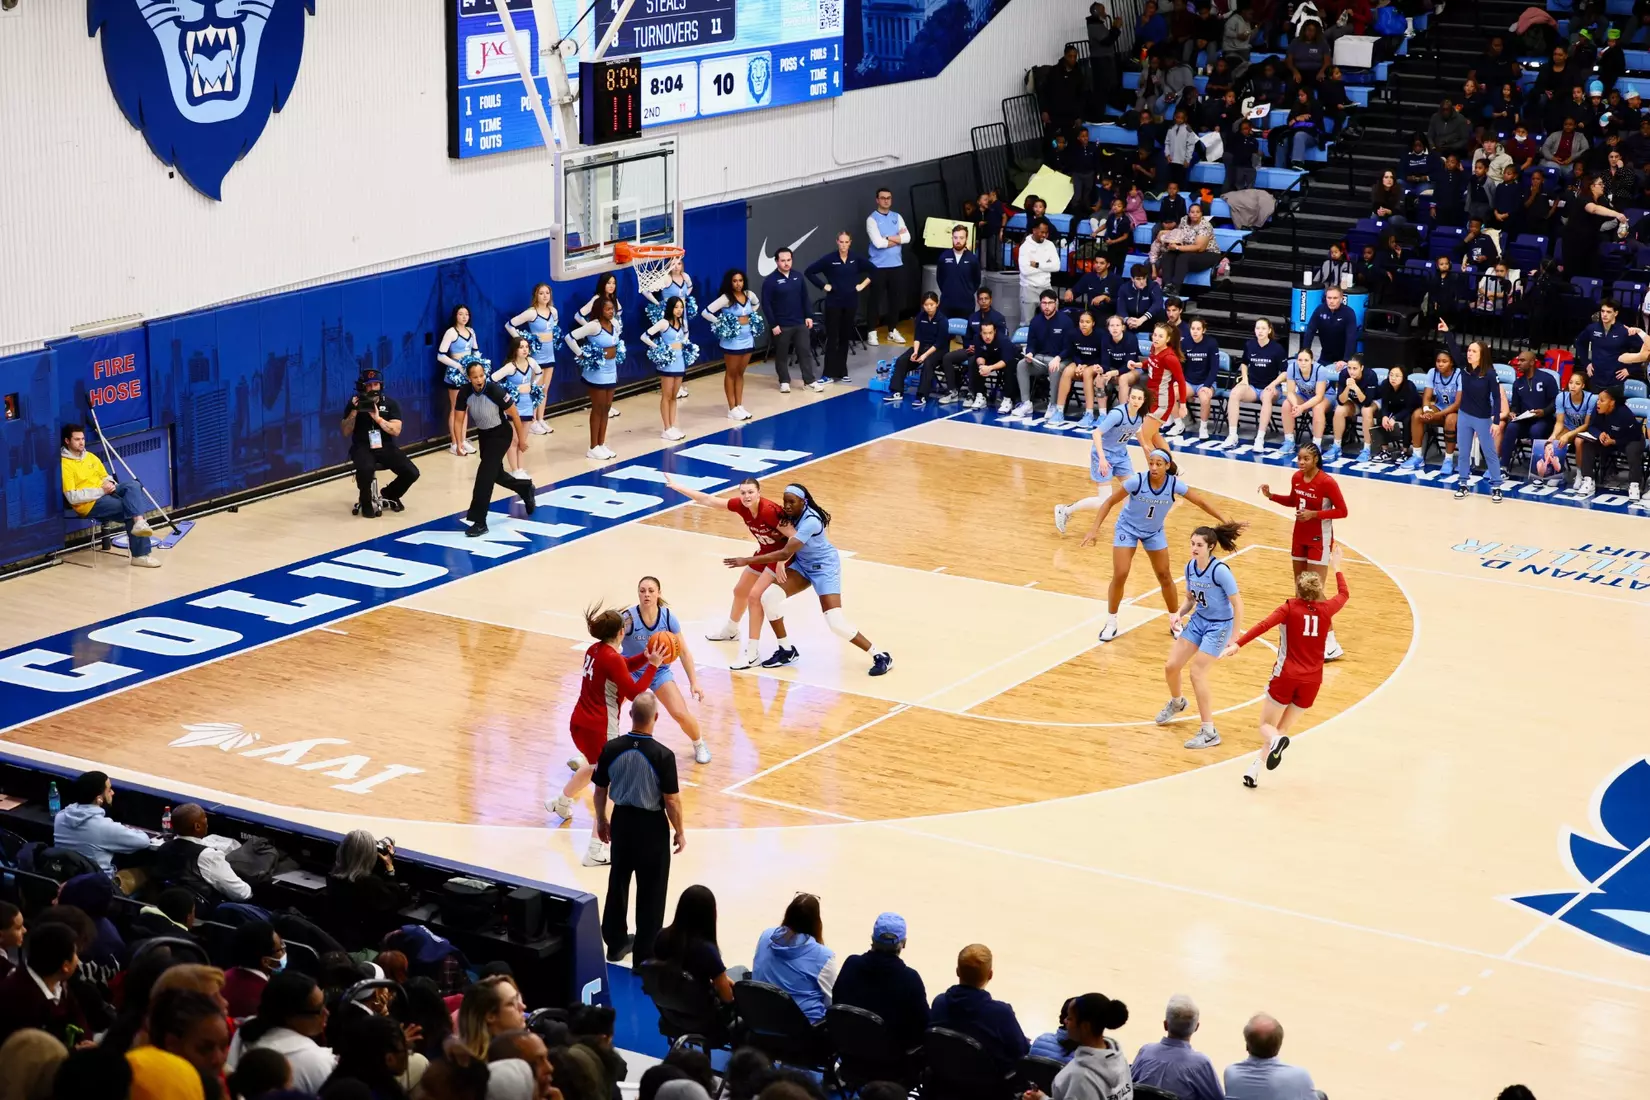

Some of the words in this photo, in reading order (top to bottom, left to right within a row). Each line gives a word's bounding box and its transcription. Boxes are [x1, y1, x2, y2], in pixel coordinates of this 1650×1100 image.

[633, 20, 699, 49] TURNOVERS
[711, 17, 722, 35] 11
[780, 56, 798, 72] POSS
[810, 47, 827, 61] FOULS
[833, 43, 839, 61] 1
[606, 66, 638, 91] 8:04
[650, 74, 684, 96] 8:04
[713, 72, 735, 97] 10
[810, 67, 828, 82] TIME
[832, 70, 839, 88] 4
[810, 82, 828, 97] OUTS
[465, 96, 473, 116] 1
[479, 94, 501, 110] FOULS
[613, 94, 633, 132] 11
[643, 105, 661, 119] 2ND
[679, 102, 686, 113] 11
[464, 127, 474, 147] 4
[479, 117, 502, 134] TIME
[480, 134, 503, 151] OUTS
[94, 353, 136, 380] FIRE
[90, 379, 141, 408] HOSE
[1536, 381, 1544, 392] C
[1442, 394, 1451, 406] 3
[1119, 432, 1133, 443] 12
[1146, 505, 1156, 519] 1
[0, 443, 813, 692] COLUMBIA
[1451, 538, 1650, 580] ILLER
[1302, 614, 1319, 638] 11
[237, 737, 426, 794] IVY
